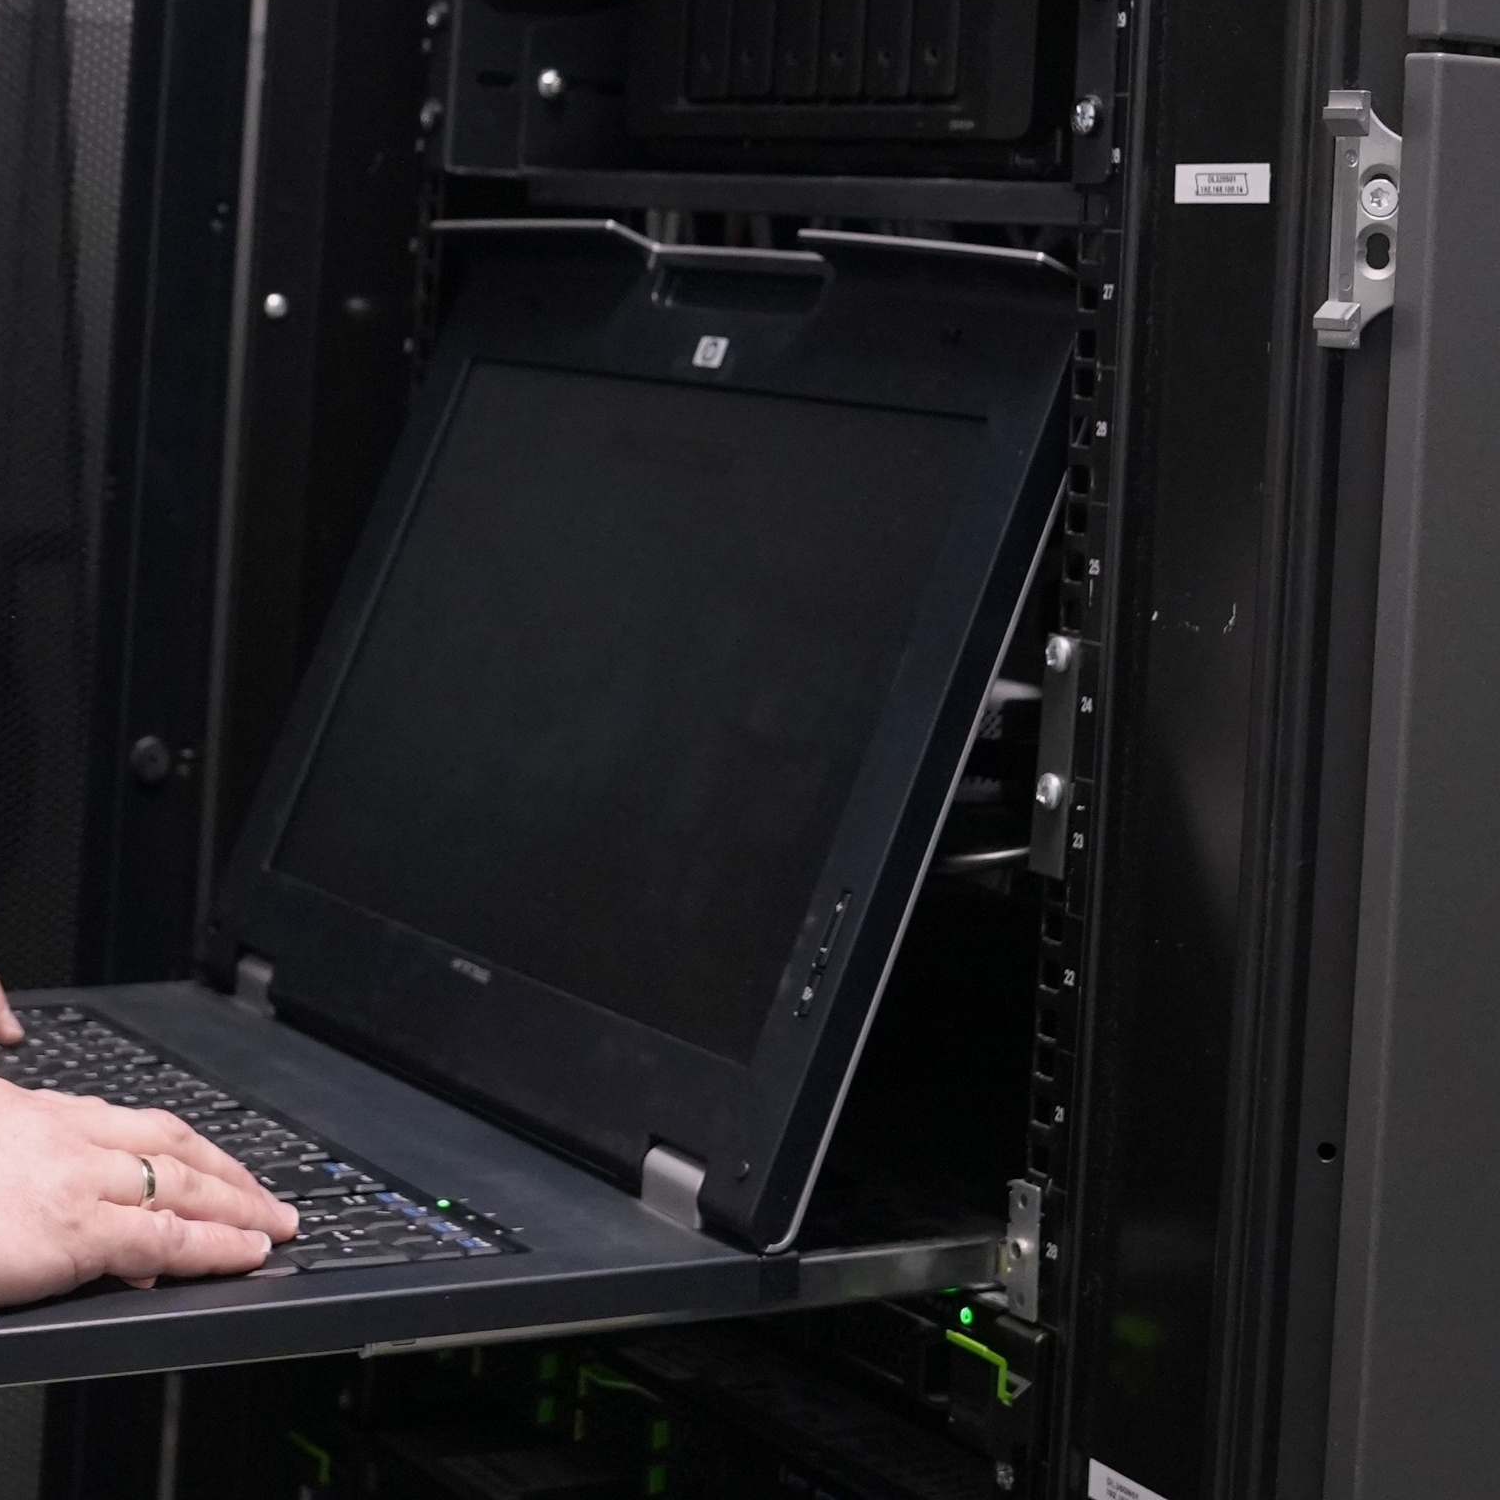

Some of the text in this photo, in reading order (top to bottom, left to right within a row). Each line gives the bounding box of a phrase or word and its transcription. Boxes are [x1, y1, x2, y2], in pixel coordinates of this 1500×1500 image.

[1102, 283, 1114, 300] 27
[1088, 558, 1100, 576] 25
[1080, 696, 1093, 713] 24
[1072, 832, 1084, 849] 23
[1063, 968, 1075, 986] 22
[1054, 1105, 1064, 1122] 21
